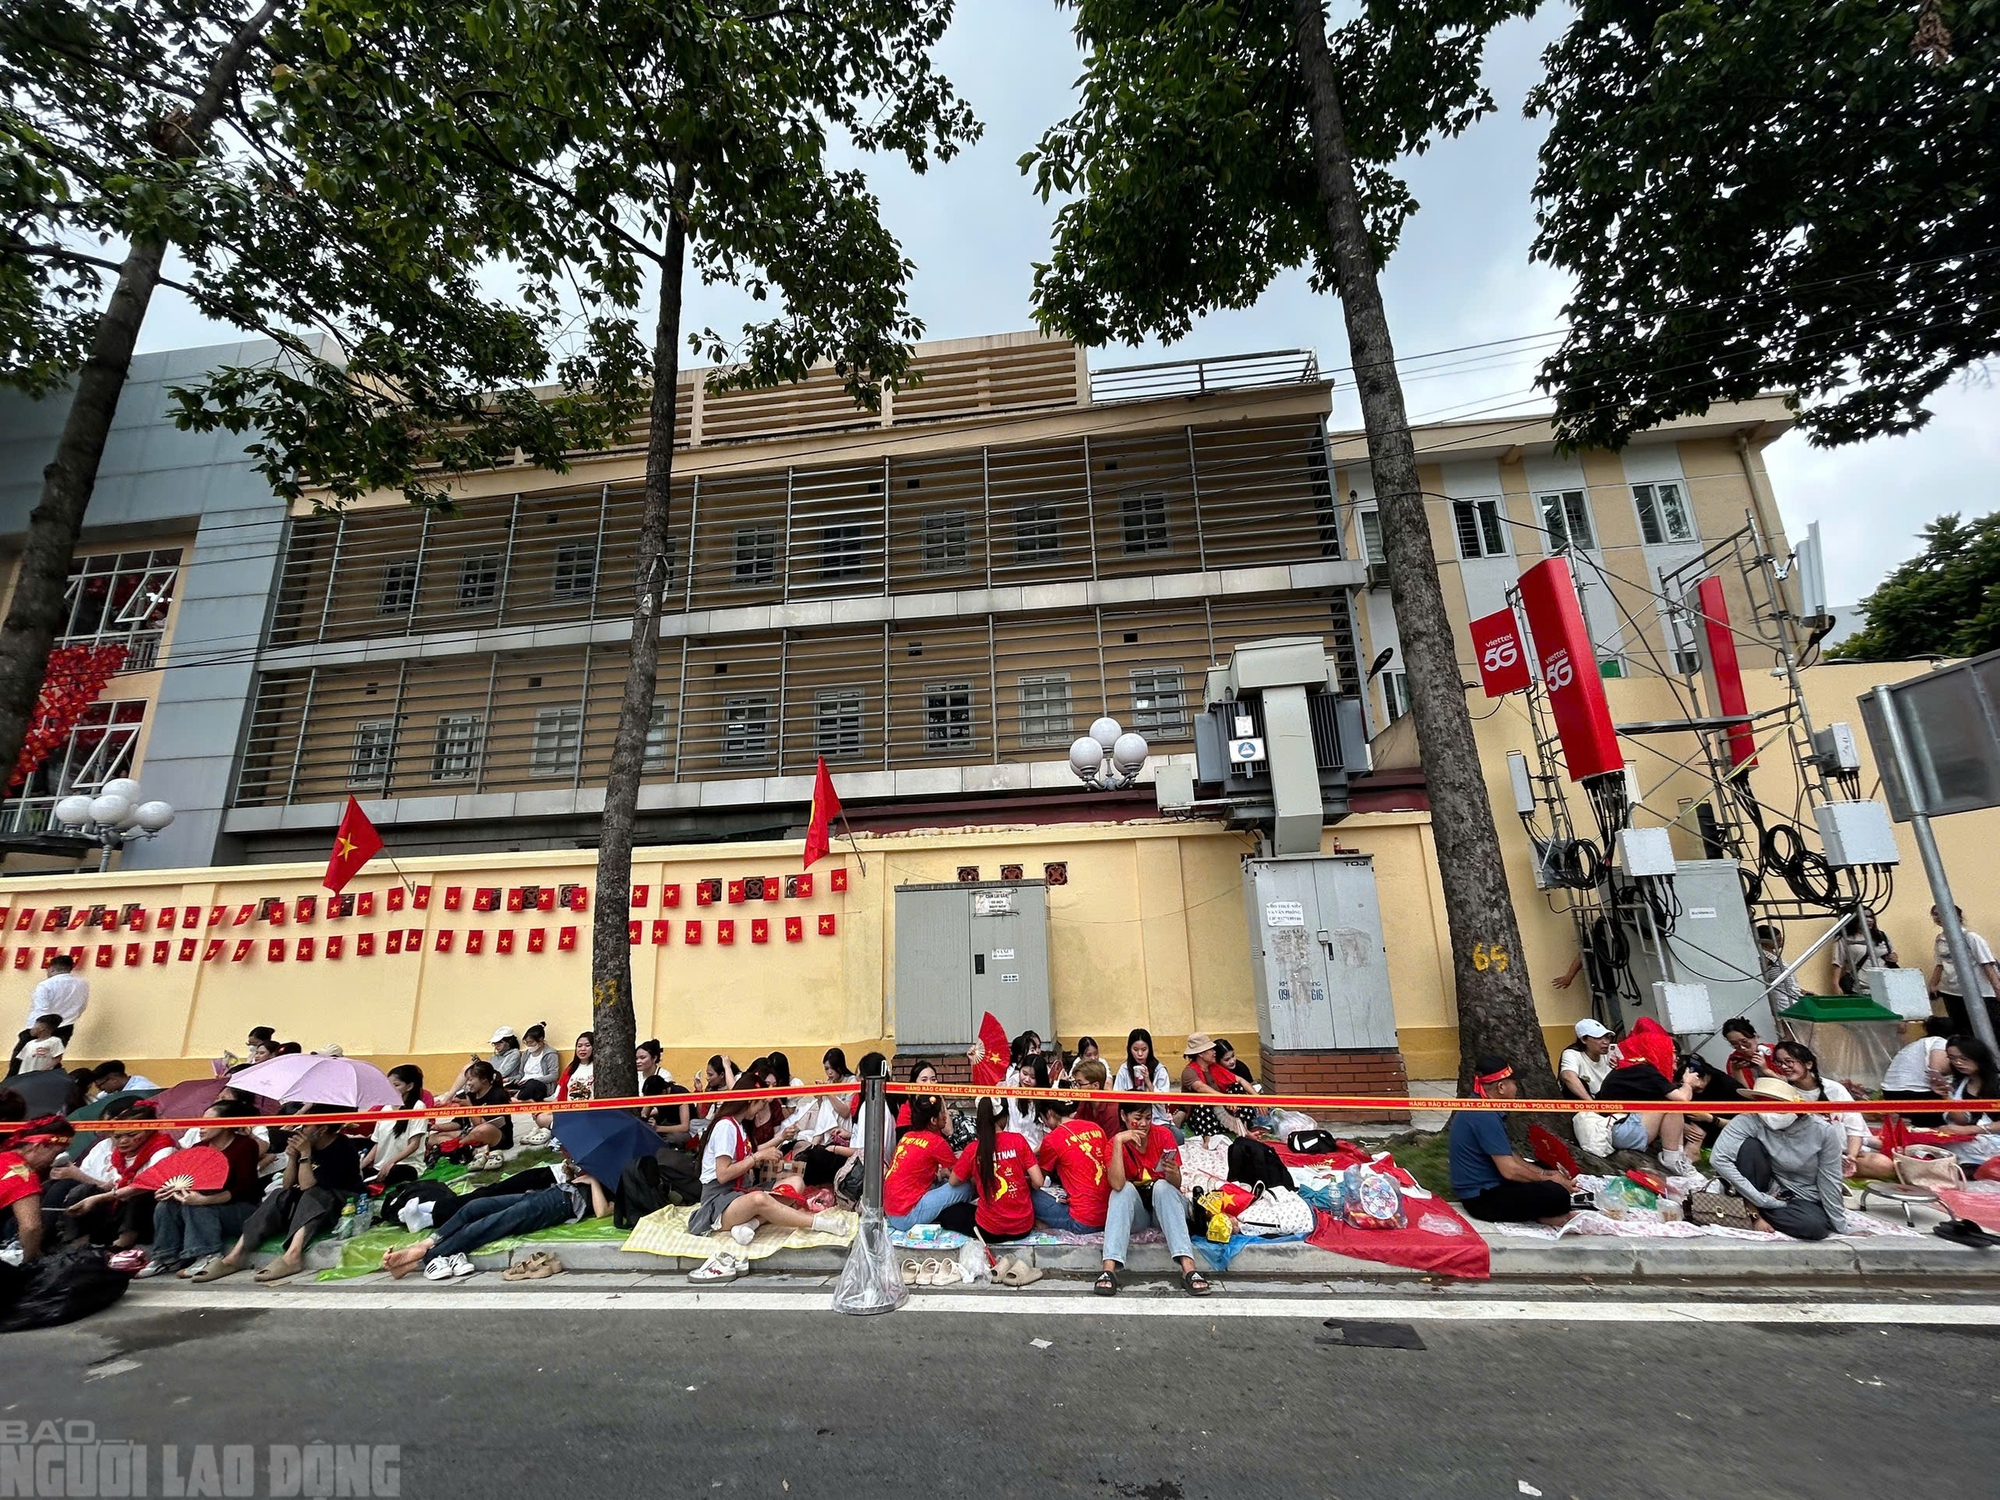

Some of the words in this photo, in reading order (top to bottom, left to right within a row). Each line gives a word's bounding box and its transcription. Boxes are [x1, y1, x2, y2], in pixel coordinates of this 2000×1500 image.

[1484, 641, 1517, 672] 5G
[1547, 656, 1573, 692] 5G
[1473, 942, 1509, 972] 65
[1001, 1148, 1017, 1160] NAM
